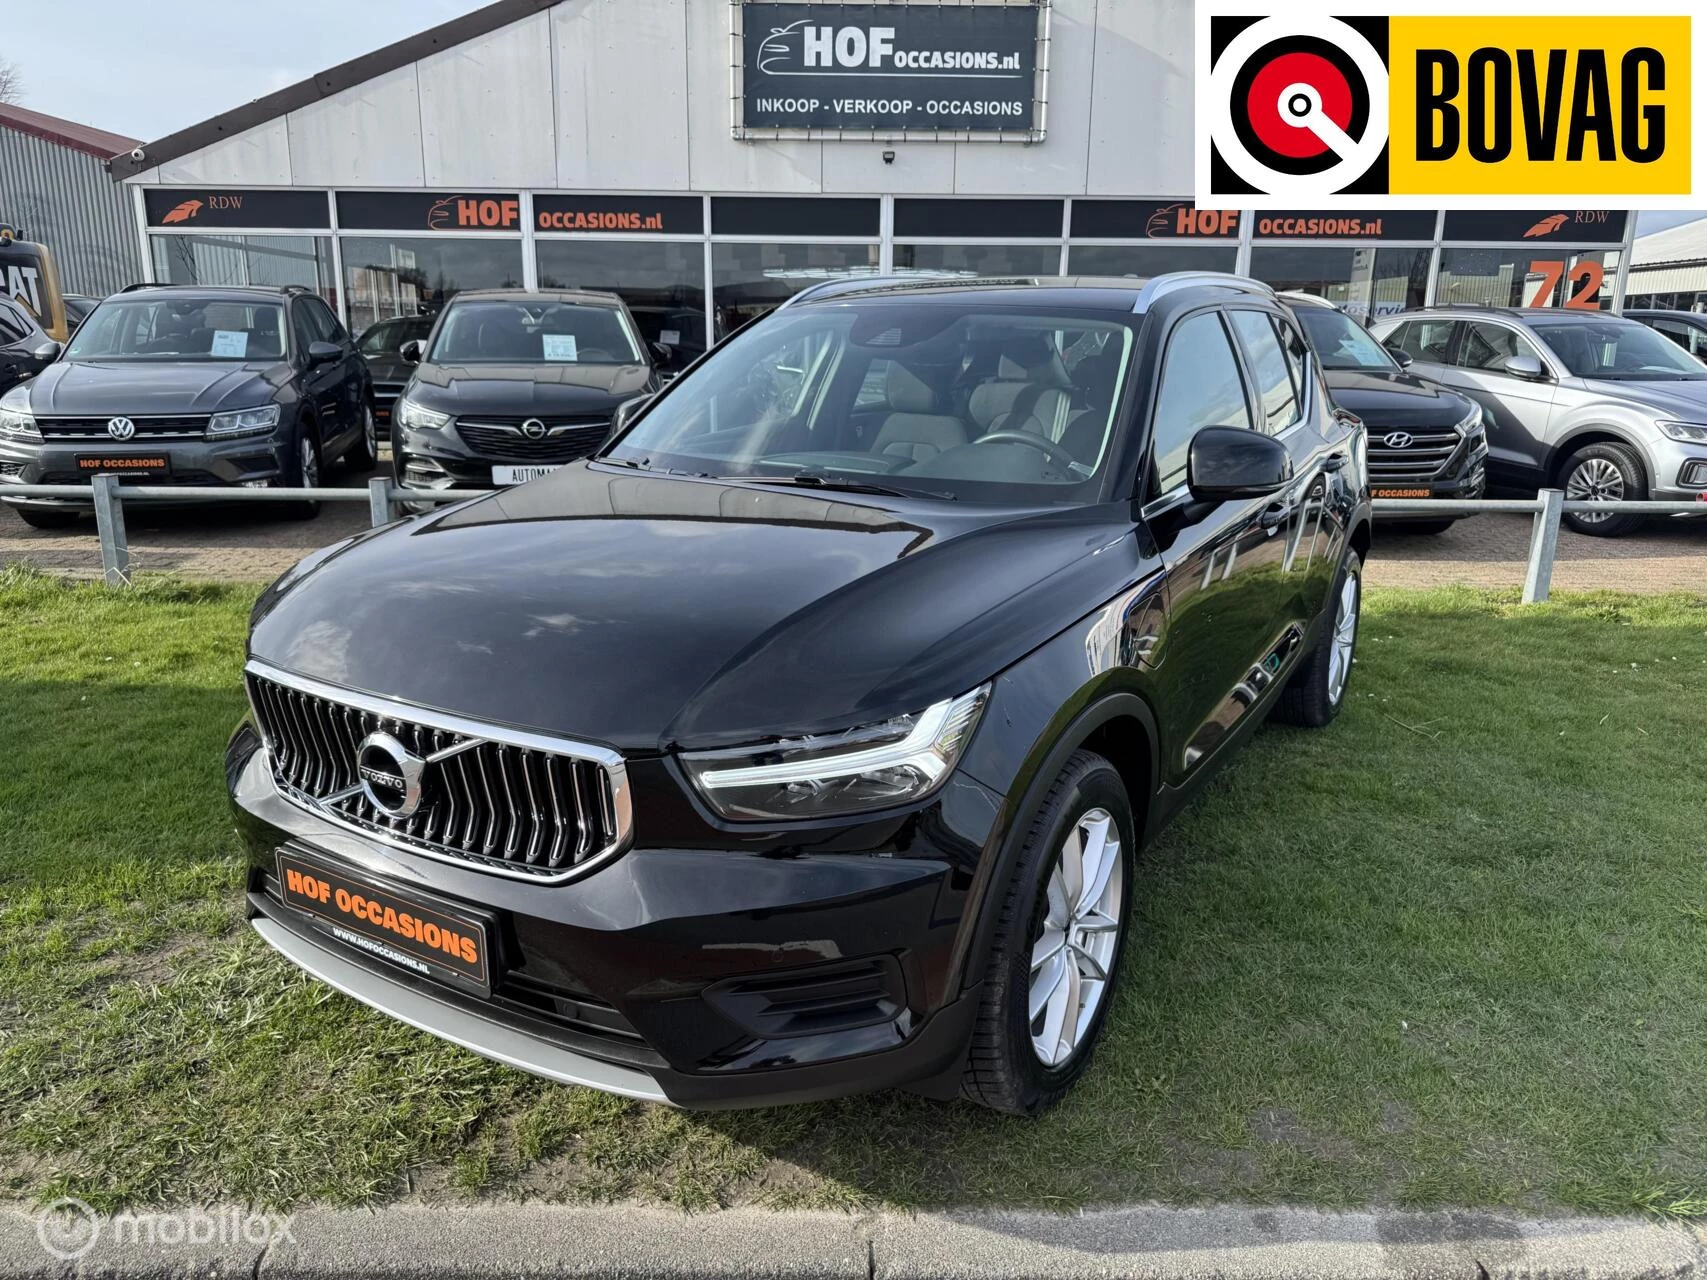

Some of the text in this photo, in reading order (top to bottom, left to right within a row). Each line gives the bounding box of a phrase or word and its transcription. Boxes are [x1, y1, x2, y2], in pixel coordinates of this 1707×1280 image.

[803, 26, 1021, 70] HOF OCCASIONS.nl
[756, 98, 1023, 116] INKOOP VERKOOP OCCASIONS
[208, 196, 243, 209] RDW
[457, 199, 664, 230] HOF OCCASIONS.nl
[1176, 208, 1383, 236] HOF OCCASIONS.nl
[1574, 210, 1611, 224] RDW
[1528, 260, 1605, 311] 72
[80, 459, 165, 468] HOF OCCASIONS
[1378, 489, 1430, 497] OCCASIONS
[360, 768, 403, 789] VOLVO
[286, 868, 479, 964] HOF OCCASIONS
[332, 927, 431, 975] WWW.HOFOCCASIONS.NL
